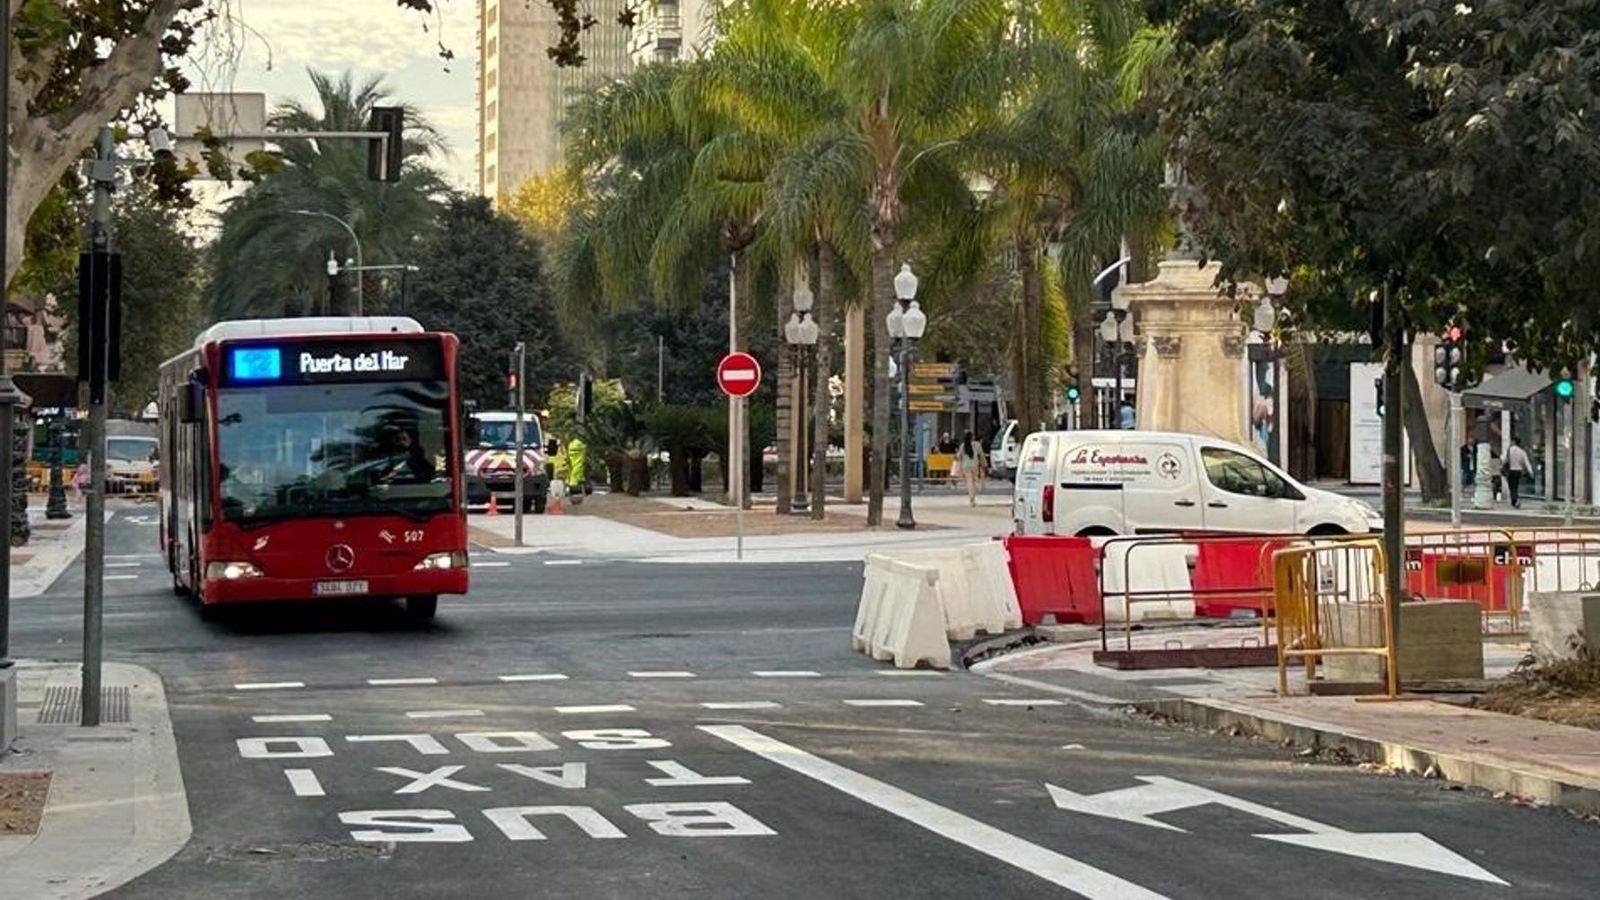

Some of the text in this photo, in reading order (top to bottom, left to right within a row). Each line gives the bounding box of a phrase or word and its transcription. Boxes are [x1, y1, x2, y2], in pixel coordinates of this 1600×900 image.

[300, 352, 352, 373] Puerta
[353, 353, 380, 371] del
[1071, 449, 1088, 464] La
[236, 728, 672, 759] SOLO
[284, 759, 752, 797] TAXI
[337, 801, 779, 843] BUS
